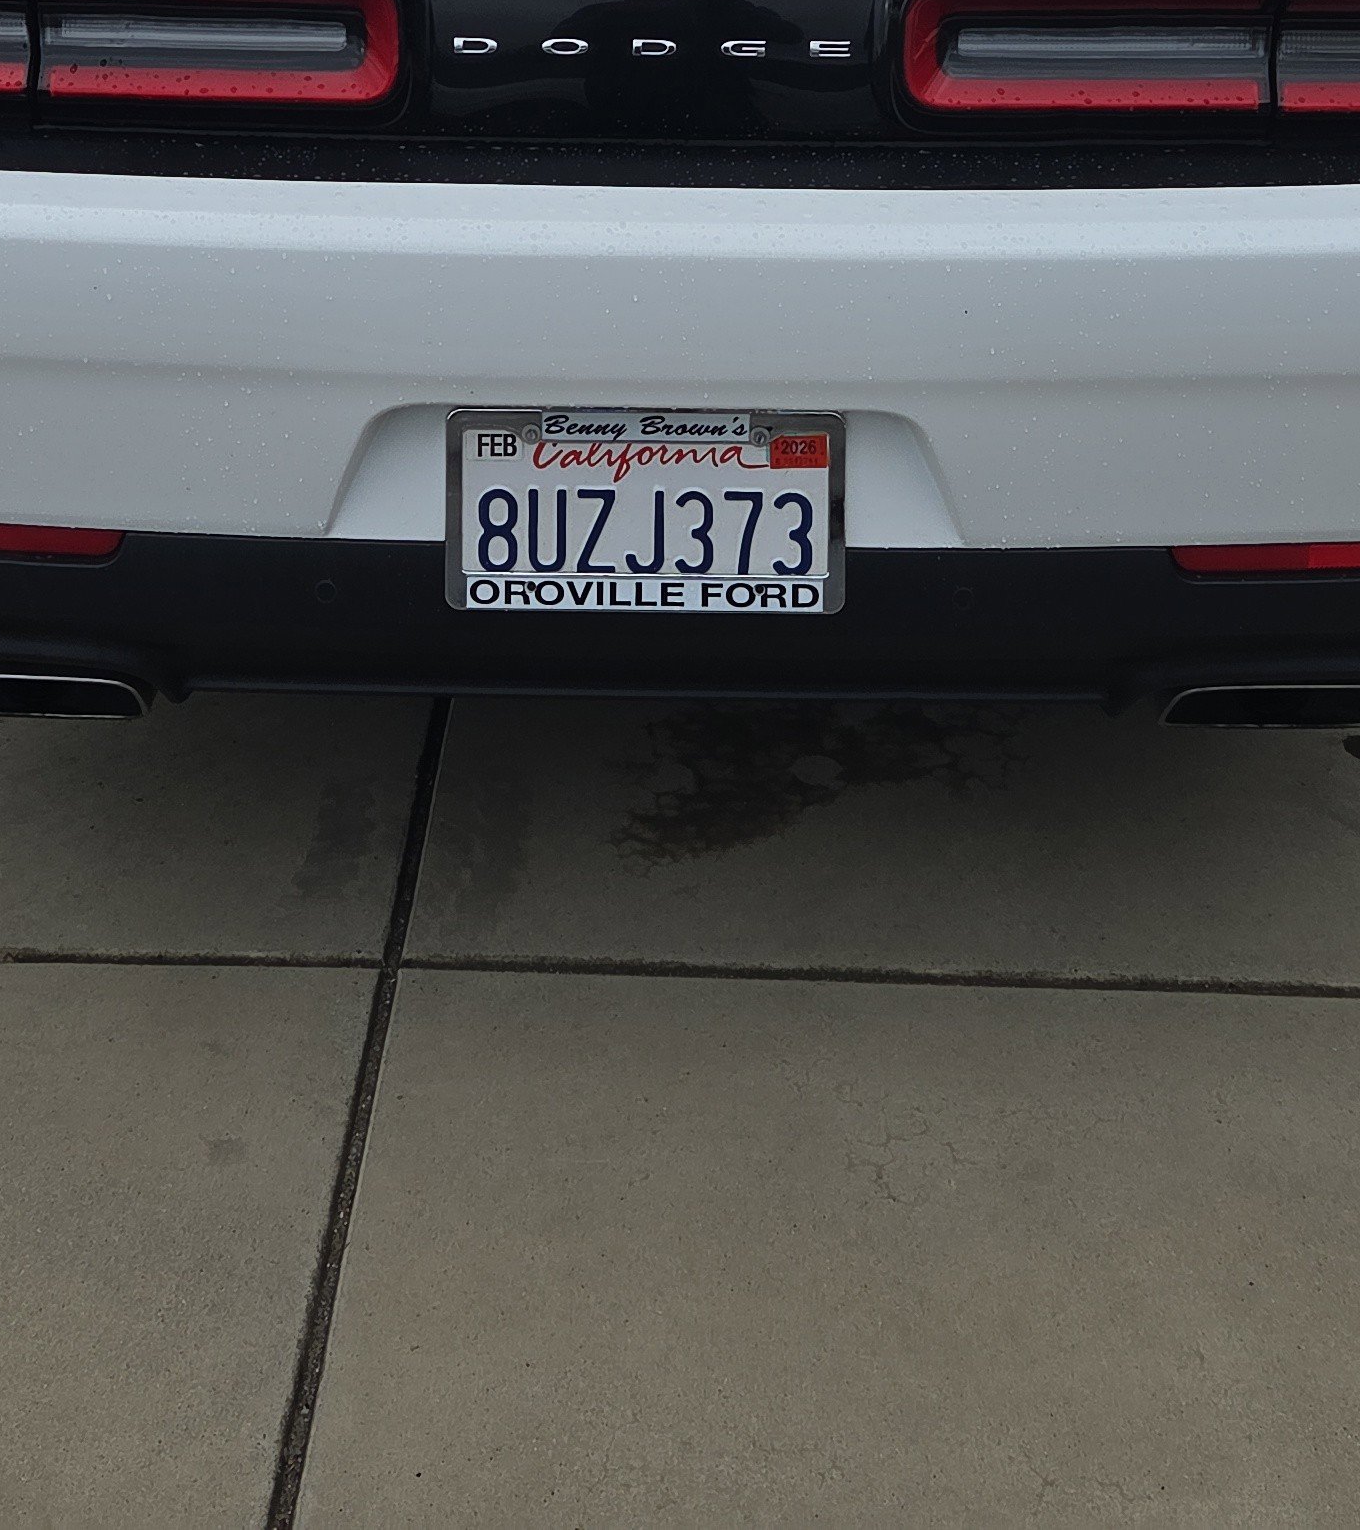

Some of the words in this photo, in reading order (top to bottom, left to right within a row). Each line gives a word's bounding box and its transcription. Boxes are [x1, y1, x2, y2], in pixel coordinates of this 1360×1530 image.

[453, 36, 851, 58] DODGE
[543, 415, 628, 440] Benny
[640, 416, 748, 437] Brown's
[477, 433, 517, 458] FEB
[781, 439, 817, 455] 2026
[533, 441, 769, 482] California
[477, 488, 813, 576] 8UZJ373
[469, 579, 684, 607] OROVILLE
[701, 582, 820, 608] FORD
